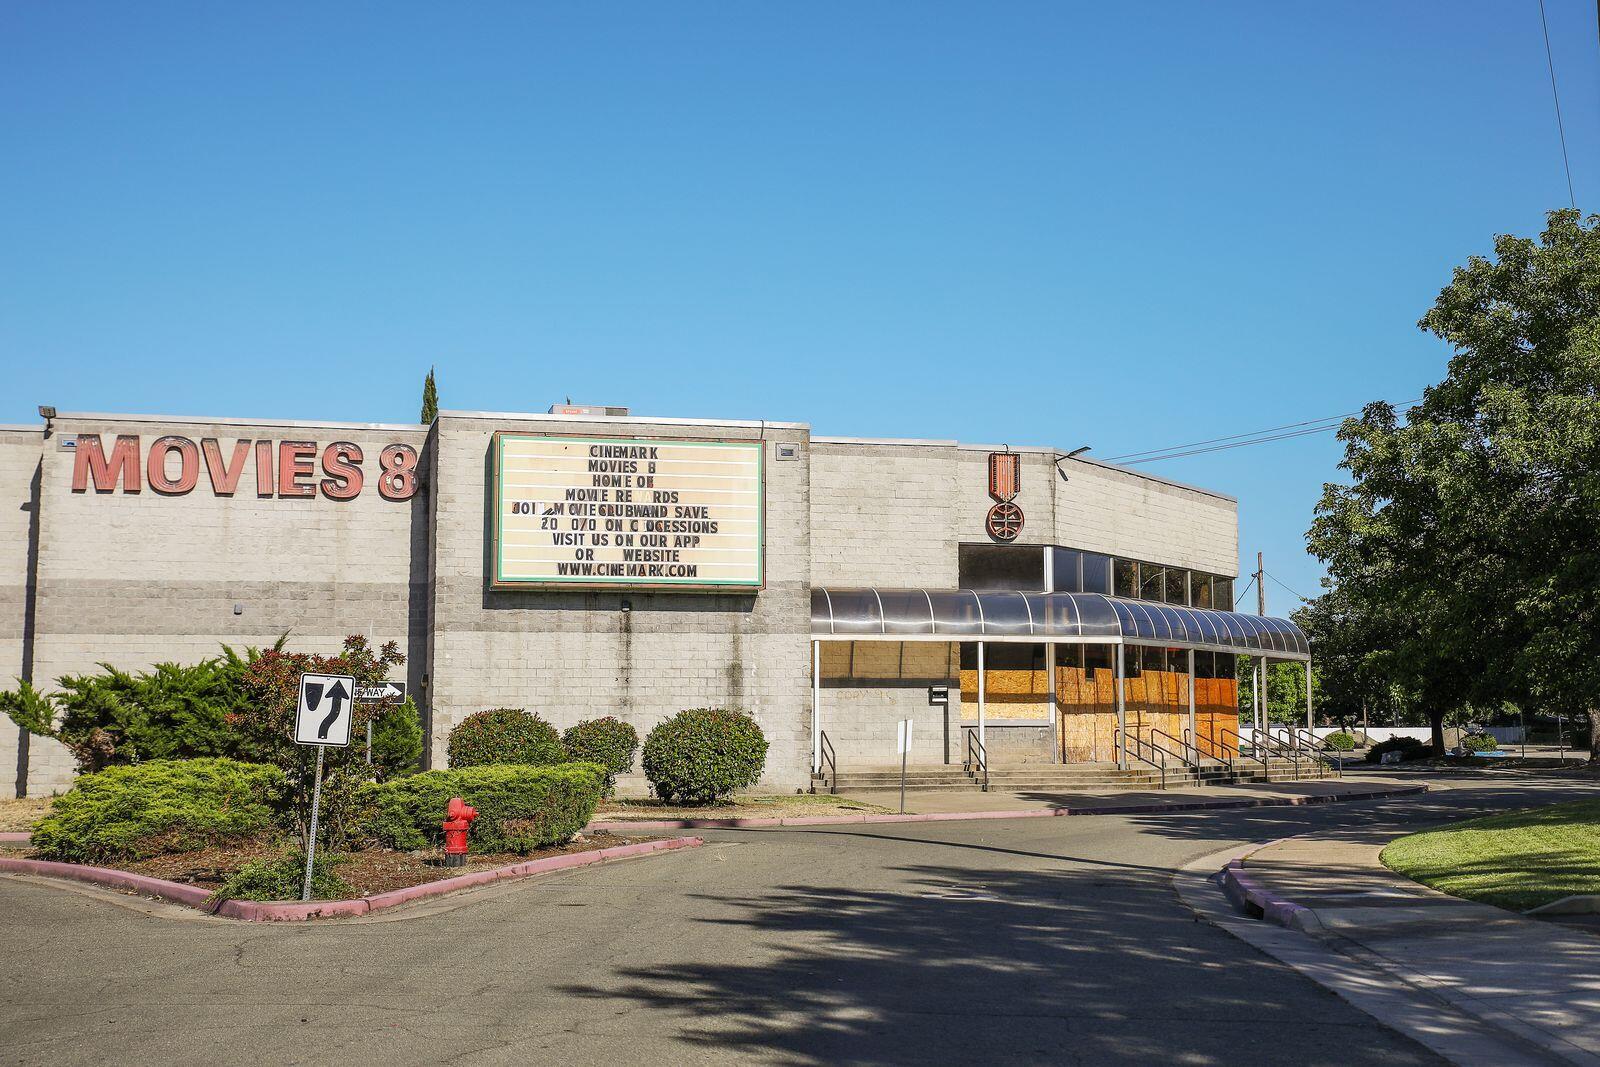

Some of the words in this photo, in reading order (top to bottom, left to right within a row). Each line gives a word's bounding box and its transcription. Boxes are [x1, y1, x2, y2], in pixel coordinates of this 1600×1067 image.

[590, 445, 658, 459] CINEMARK
[71, 433, 364, 501] MOVIES
[378, 443, 420, 502] 8
[588, 460, 638, 473] MOVIES
[592, 474, 632, 488] HOME
[565, 488, 608, 502] MOVIE
[615, 489, 679, 503] RERDS
[541, 517, 558, 530] 20
[605, 518, 623, 531] ON
[552, 532, 585, 546] VISIT
[591, 533, 609, 546] US
[614, 534, 634, 547] ON
[639, 534, 668, 547] OUR
[673, 535, 701, 548] APP
[575, 548, 594, 561] OR
[623, 549, 680, 562] WEBSITE
[557, 562, 697, 577] WWW.CINEMARK.COM
